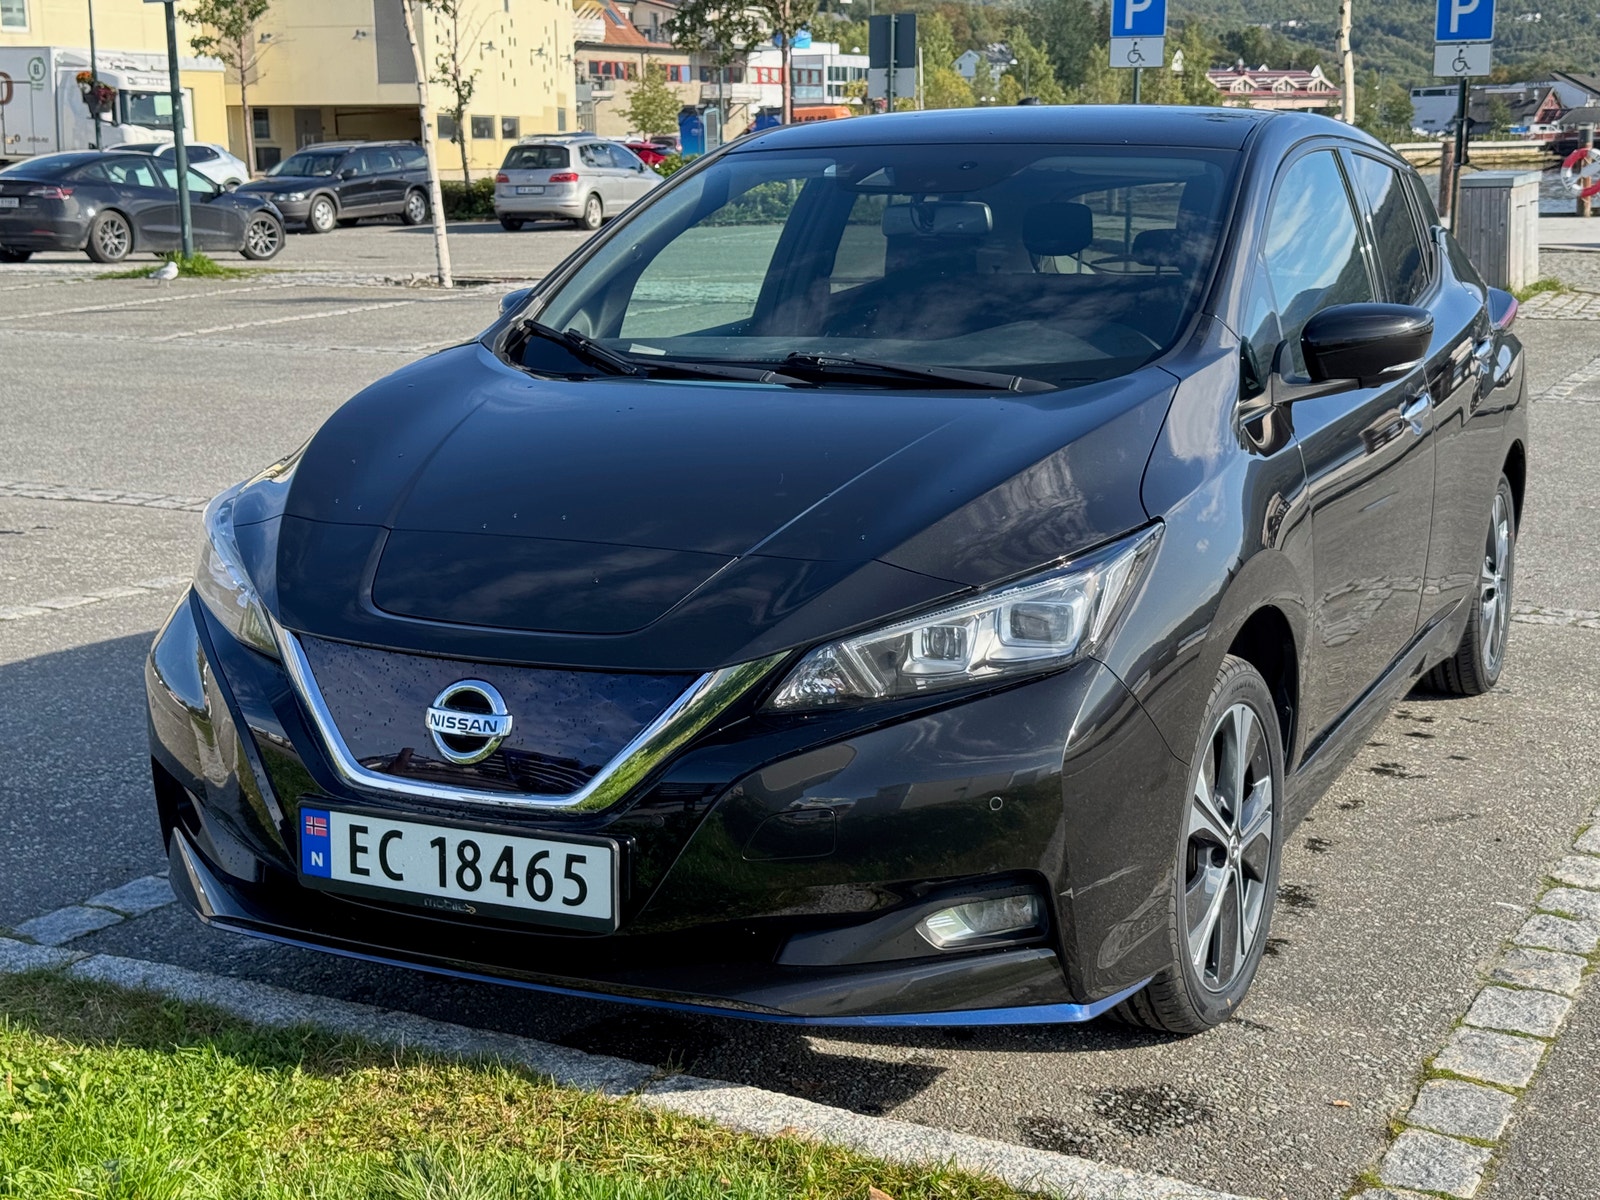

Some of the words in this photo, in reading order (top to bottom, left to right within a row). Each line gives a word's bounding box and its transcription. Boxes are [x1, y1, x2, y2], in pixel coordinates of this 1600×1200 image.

[1124, 0, 1152, 29] P
[1450, 0, 1480, 33] P
[430, 713, 498, 733] NISSAN
[311, 851, 324, 868] N
[348, 824, 405, 882] EC
[430, 836, 588, 906] 18465
